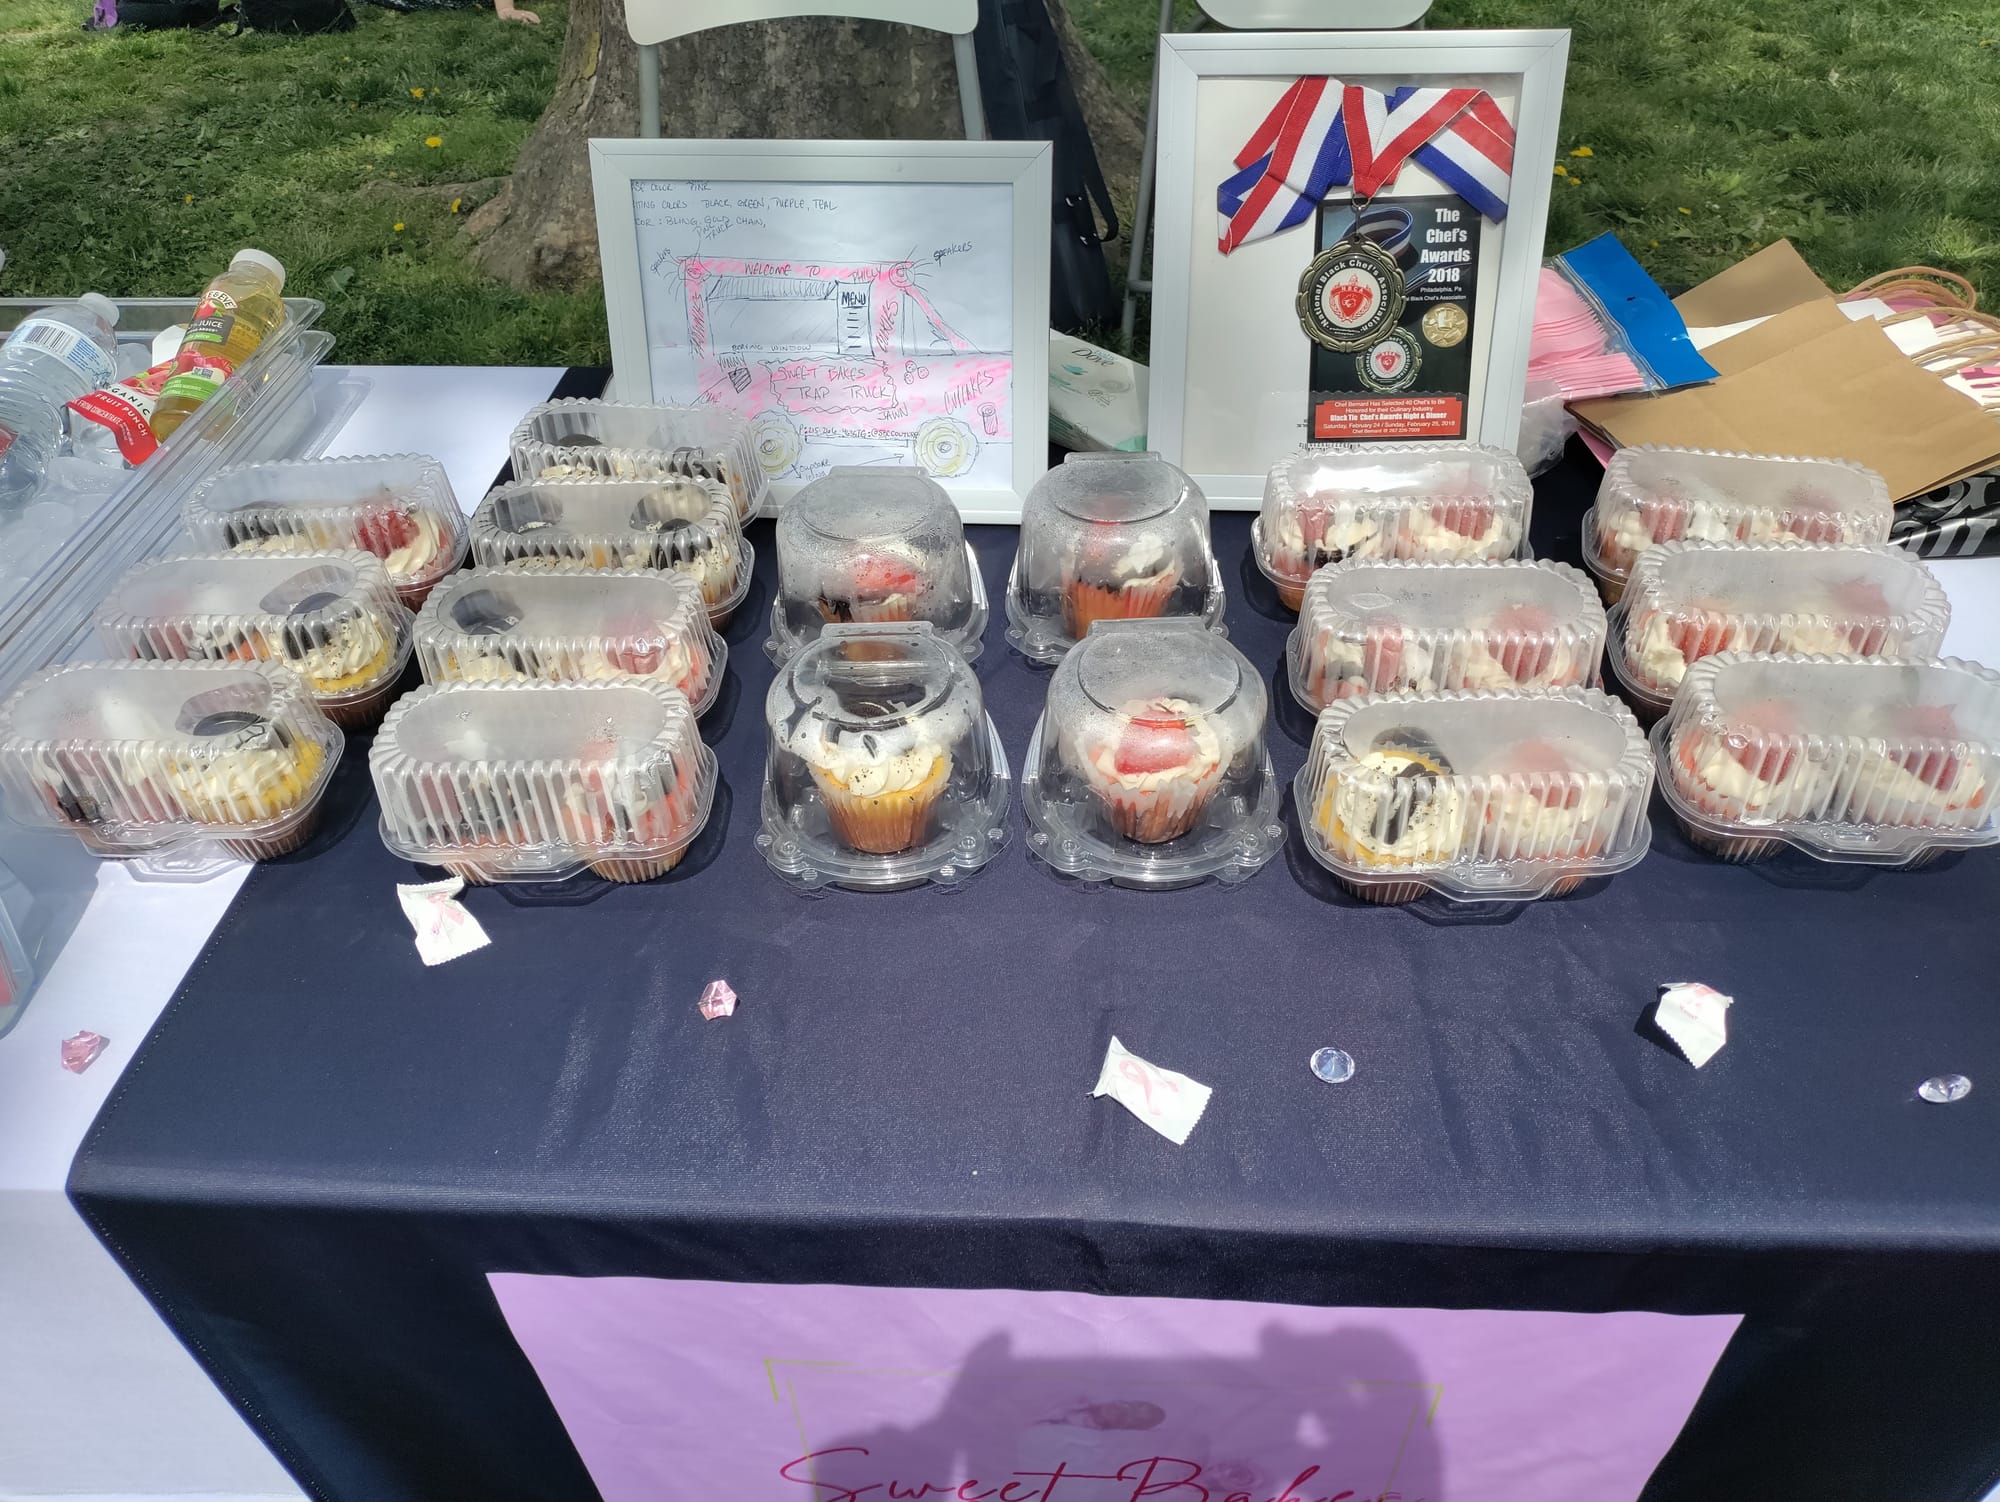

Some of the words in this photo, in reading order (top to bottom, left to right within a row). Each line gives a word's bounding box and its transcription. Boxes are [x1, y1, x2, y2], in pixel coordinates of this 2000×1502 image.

[812, 198, 838, 211] TEAL
[1435, 208, 1460, 223] The
[1425, 228, 1468, 243] Chef's
[1420, 248, 1471, 263] Awards
[744, 262, 793, 276] WELCOME
[806, 265, 820, 277] TO
[847, 264, 881, 285] PHILLY
[1319, 261, 1346, 284] Black
[1348, 259, 1380, 276] Chef's
[1428, 267, 1460, 283] 2018
[1420, 286, 1453, 294] Philadelphia,
[840, 290, 867, 307] MENU
[1314, 284, 1330, 328] National
[1360, 275, 1388, 332] Association
[199, 319, 224, 329] JUICE
[771, 344, 812, 352] WINDOW
[1071, 347, 1115, 368] Dove
[772, 364, 817, 382] SWEET
[819, 364, 866, 382] BAKES
[786, 385, 830, 400] TRAP
[843, 384, 891, 400] TRUCK
[95, 393, 123, 409] FRUIT
[121, 405, 149, 437] PUNCH
[876, 401, 909, 421] JAWN
[1330, 414, 1348, 422] Black
[1348, 413, 1358, 421] Tie
[1379, 413, 1402, 421] Awards
[1403, 412, 1420, 421] Night
[1412, 405, 1434, 413] Industry
[1348, 422, 1372, 430] February
[1407, 420, 1431, 428] February
[780, 1447, 1137, 1502] Sweet
